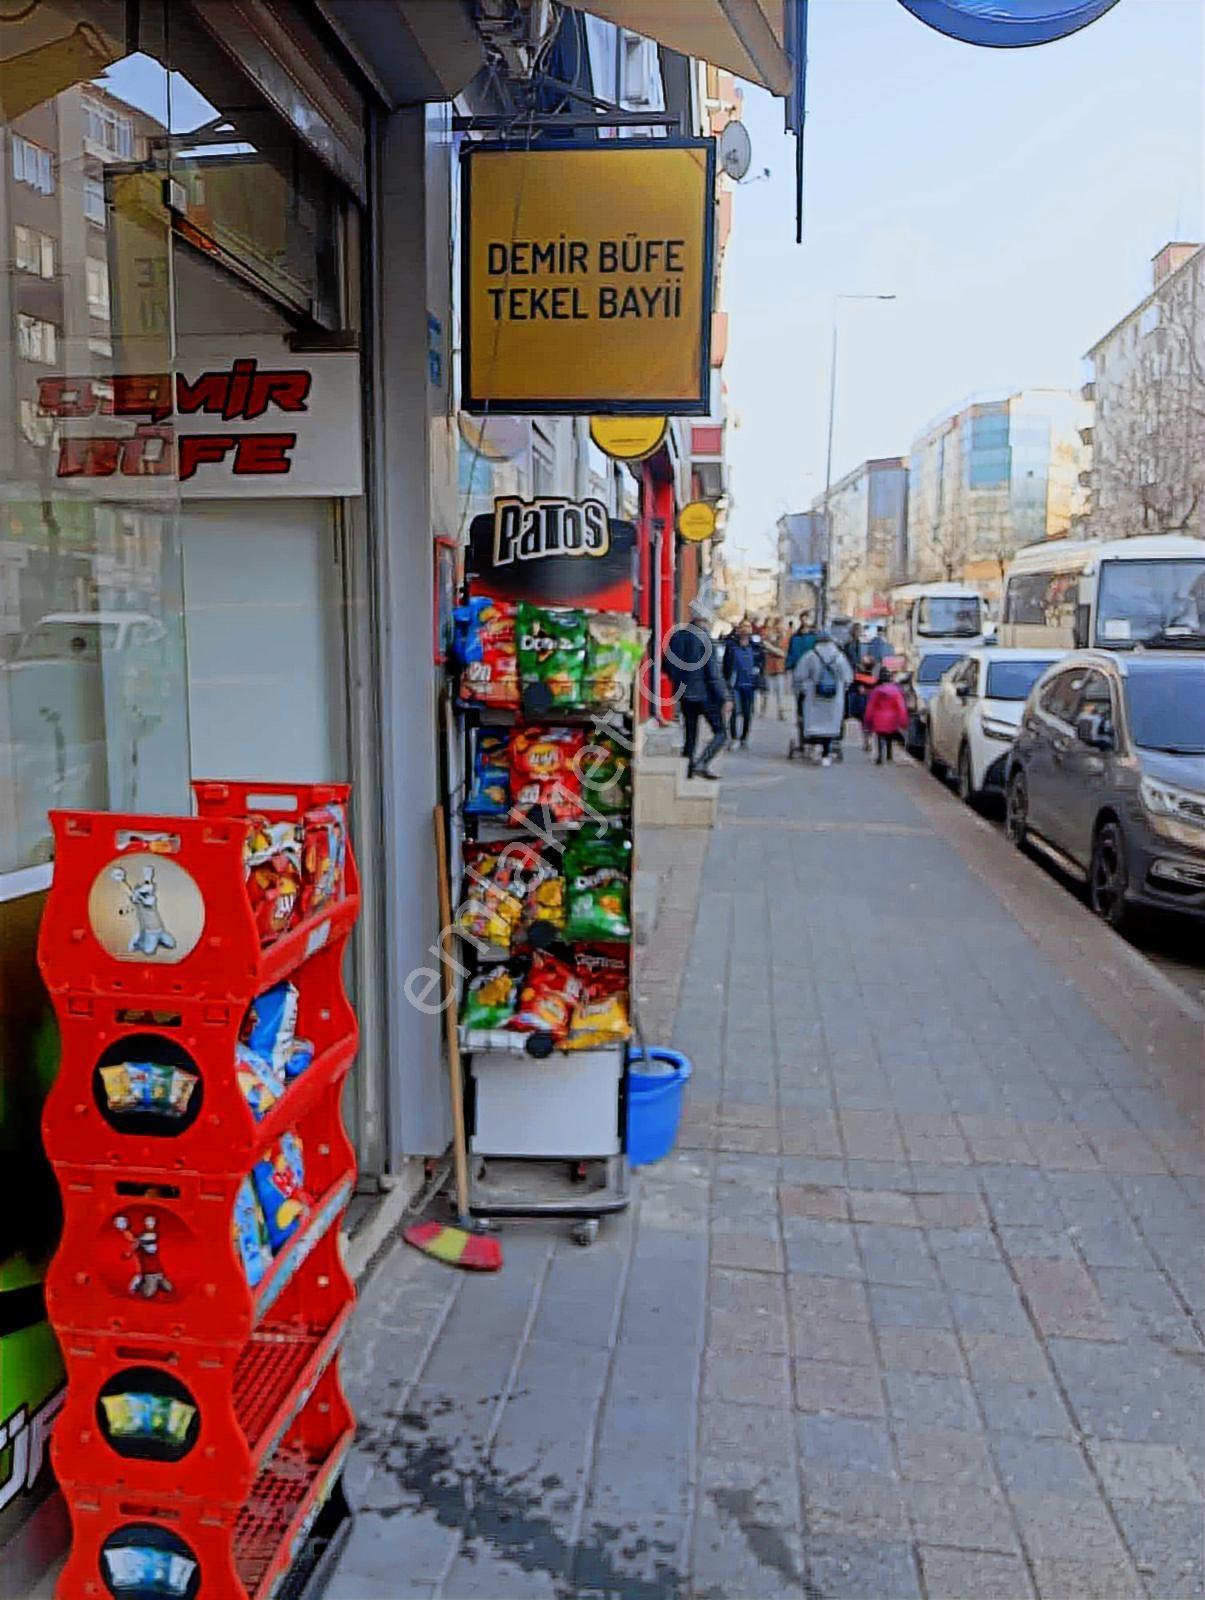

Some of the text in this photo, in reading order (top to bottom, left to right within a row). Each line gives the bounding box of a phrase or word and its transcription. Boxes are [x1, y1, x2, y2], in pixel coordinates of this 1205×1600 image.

[487, 232, 685, 275] DEMİR BÜFE
[487, 287, 589, 321] TEKEL
